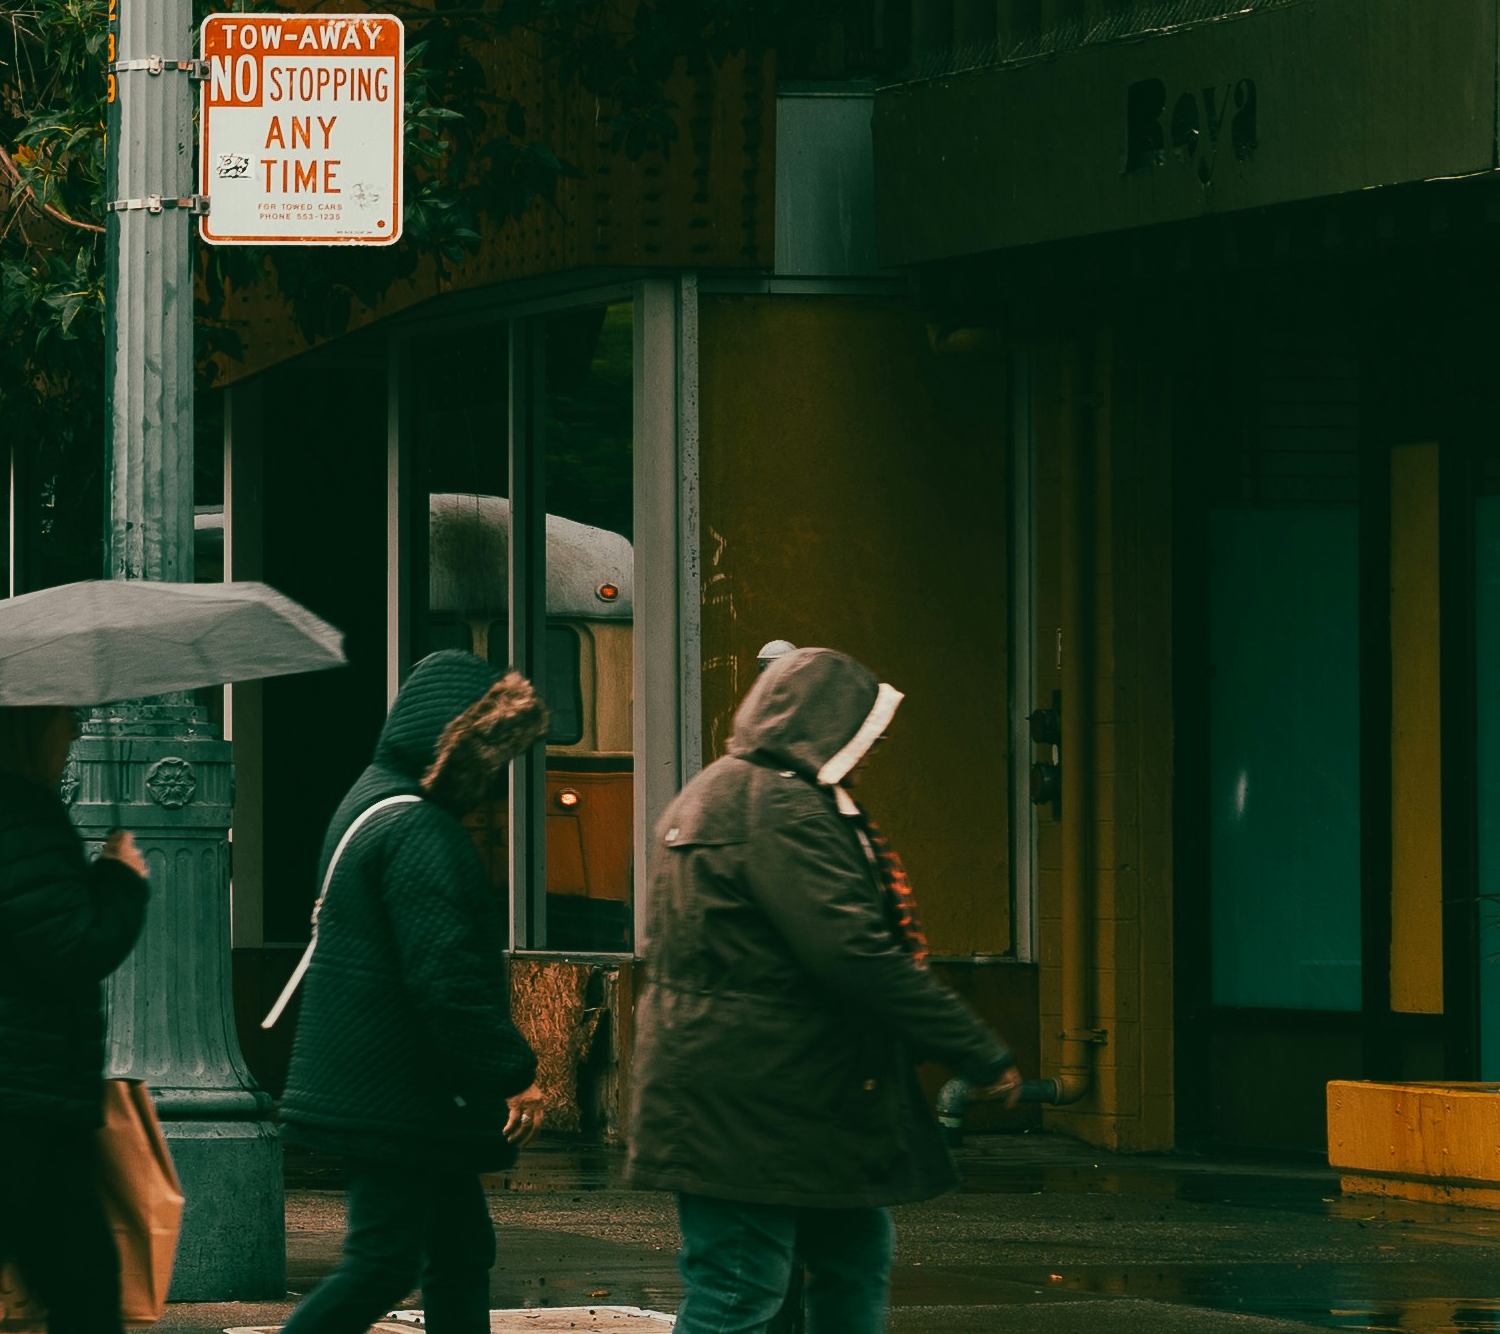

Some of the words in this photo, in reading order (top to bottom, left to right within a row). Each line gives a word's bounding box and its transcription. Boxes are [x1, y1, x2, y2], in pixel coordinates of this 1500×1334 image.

[221, 24, 383, 50] TOW-AWAY
[210, 54, 259, 103] NO
[269, 66, 389, 102] STOPPING
[264, 115, 338, 149] ANY
[260, 159, 342, 194] TIME
